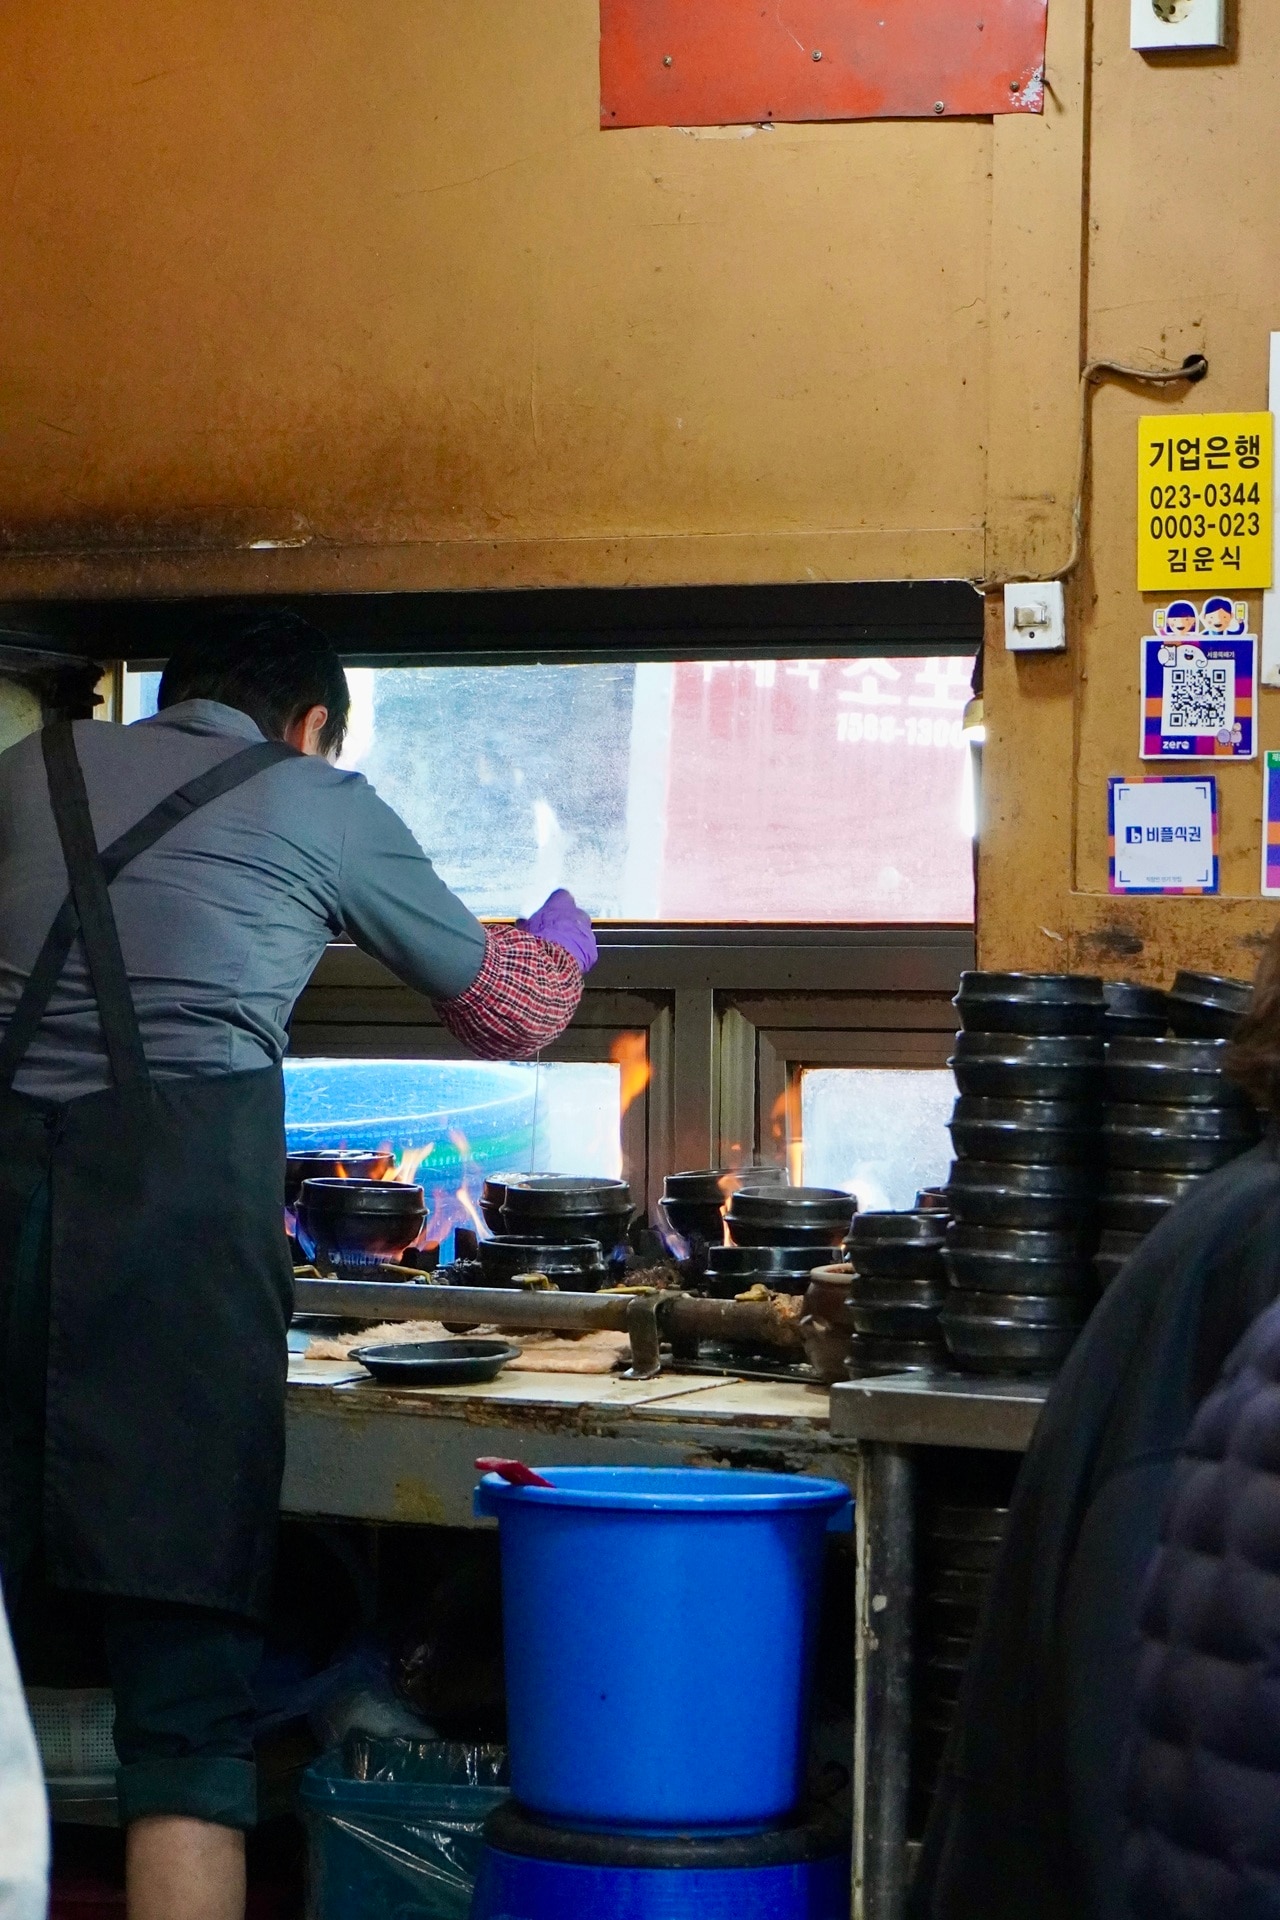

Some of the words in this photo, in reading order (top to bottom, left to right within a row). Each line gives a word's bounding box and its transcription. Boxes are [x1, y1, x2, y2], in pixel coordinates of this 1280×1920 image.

[1149, 435, 1260, 472] 기업은행
[1150, 482, 1260, 509] 023-0344
[1150, 512, 1260, 539] 0003-023
[1167, 545, 1240, 573] 김운식
[1146, 826, 1201, 843] 비플식권
